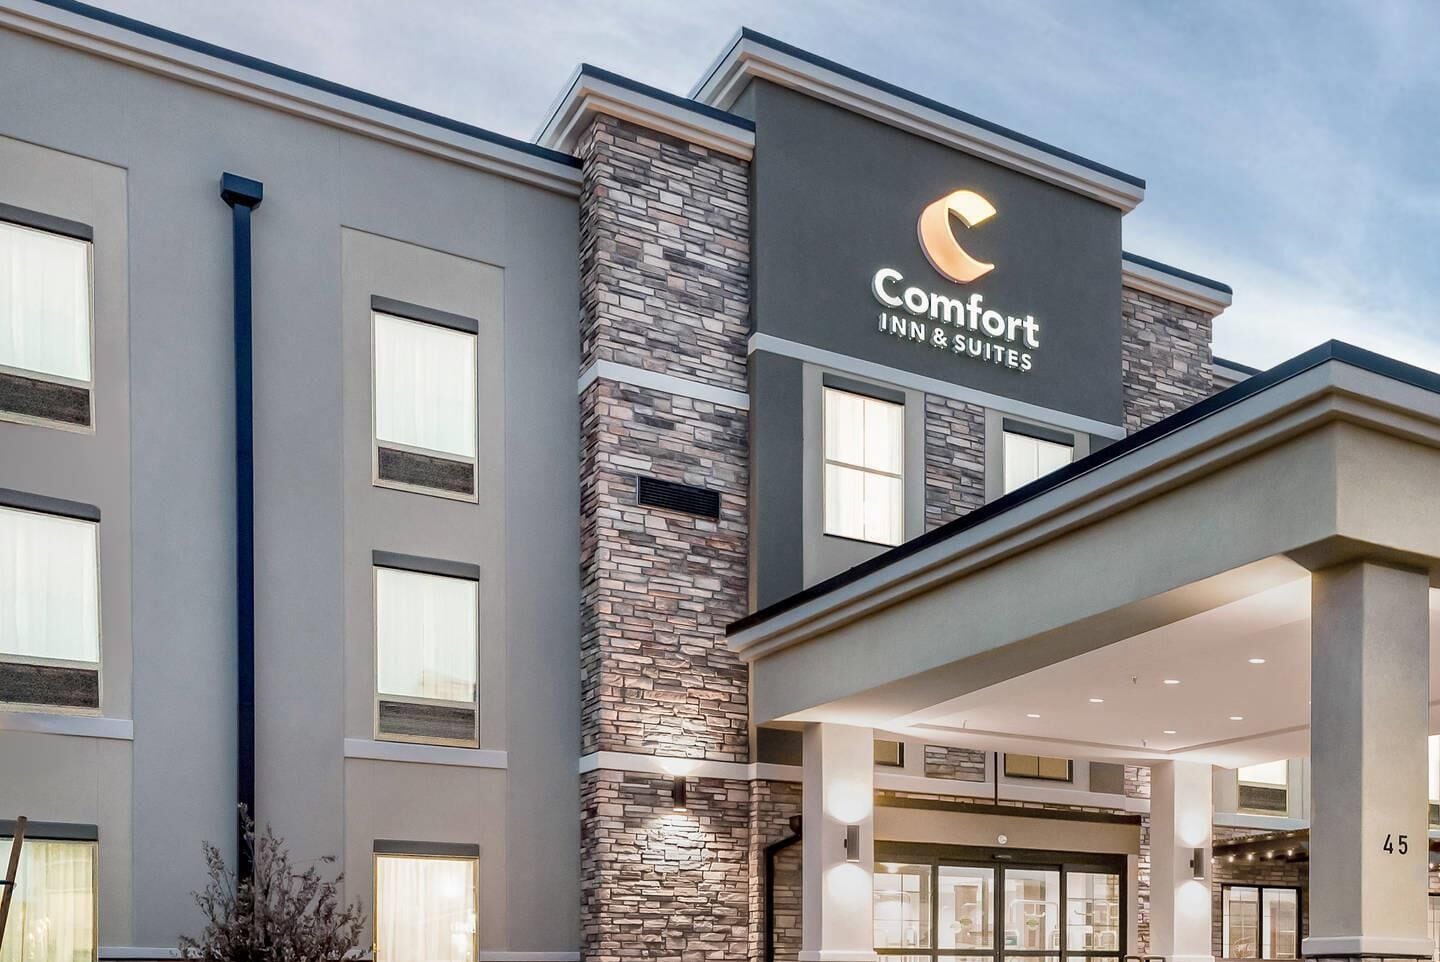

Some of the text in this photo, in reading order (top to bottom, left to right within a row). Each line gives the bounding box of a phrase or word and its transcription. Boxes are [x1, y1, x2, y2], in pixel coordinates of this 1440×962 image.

[872, 267, 1040, 349] Comfort
[878, 311, 1033, 372] INN & SUITES
[1382, 833, 1409, 855] 45
